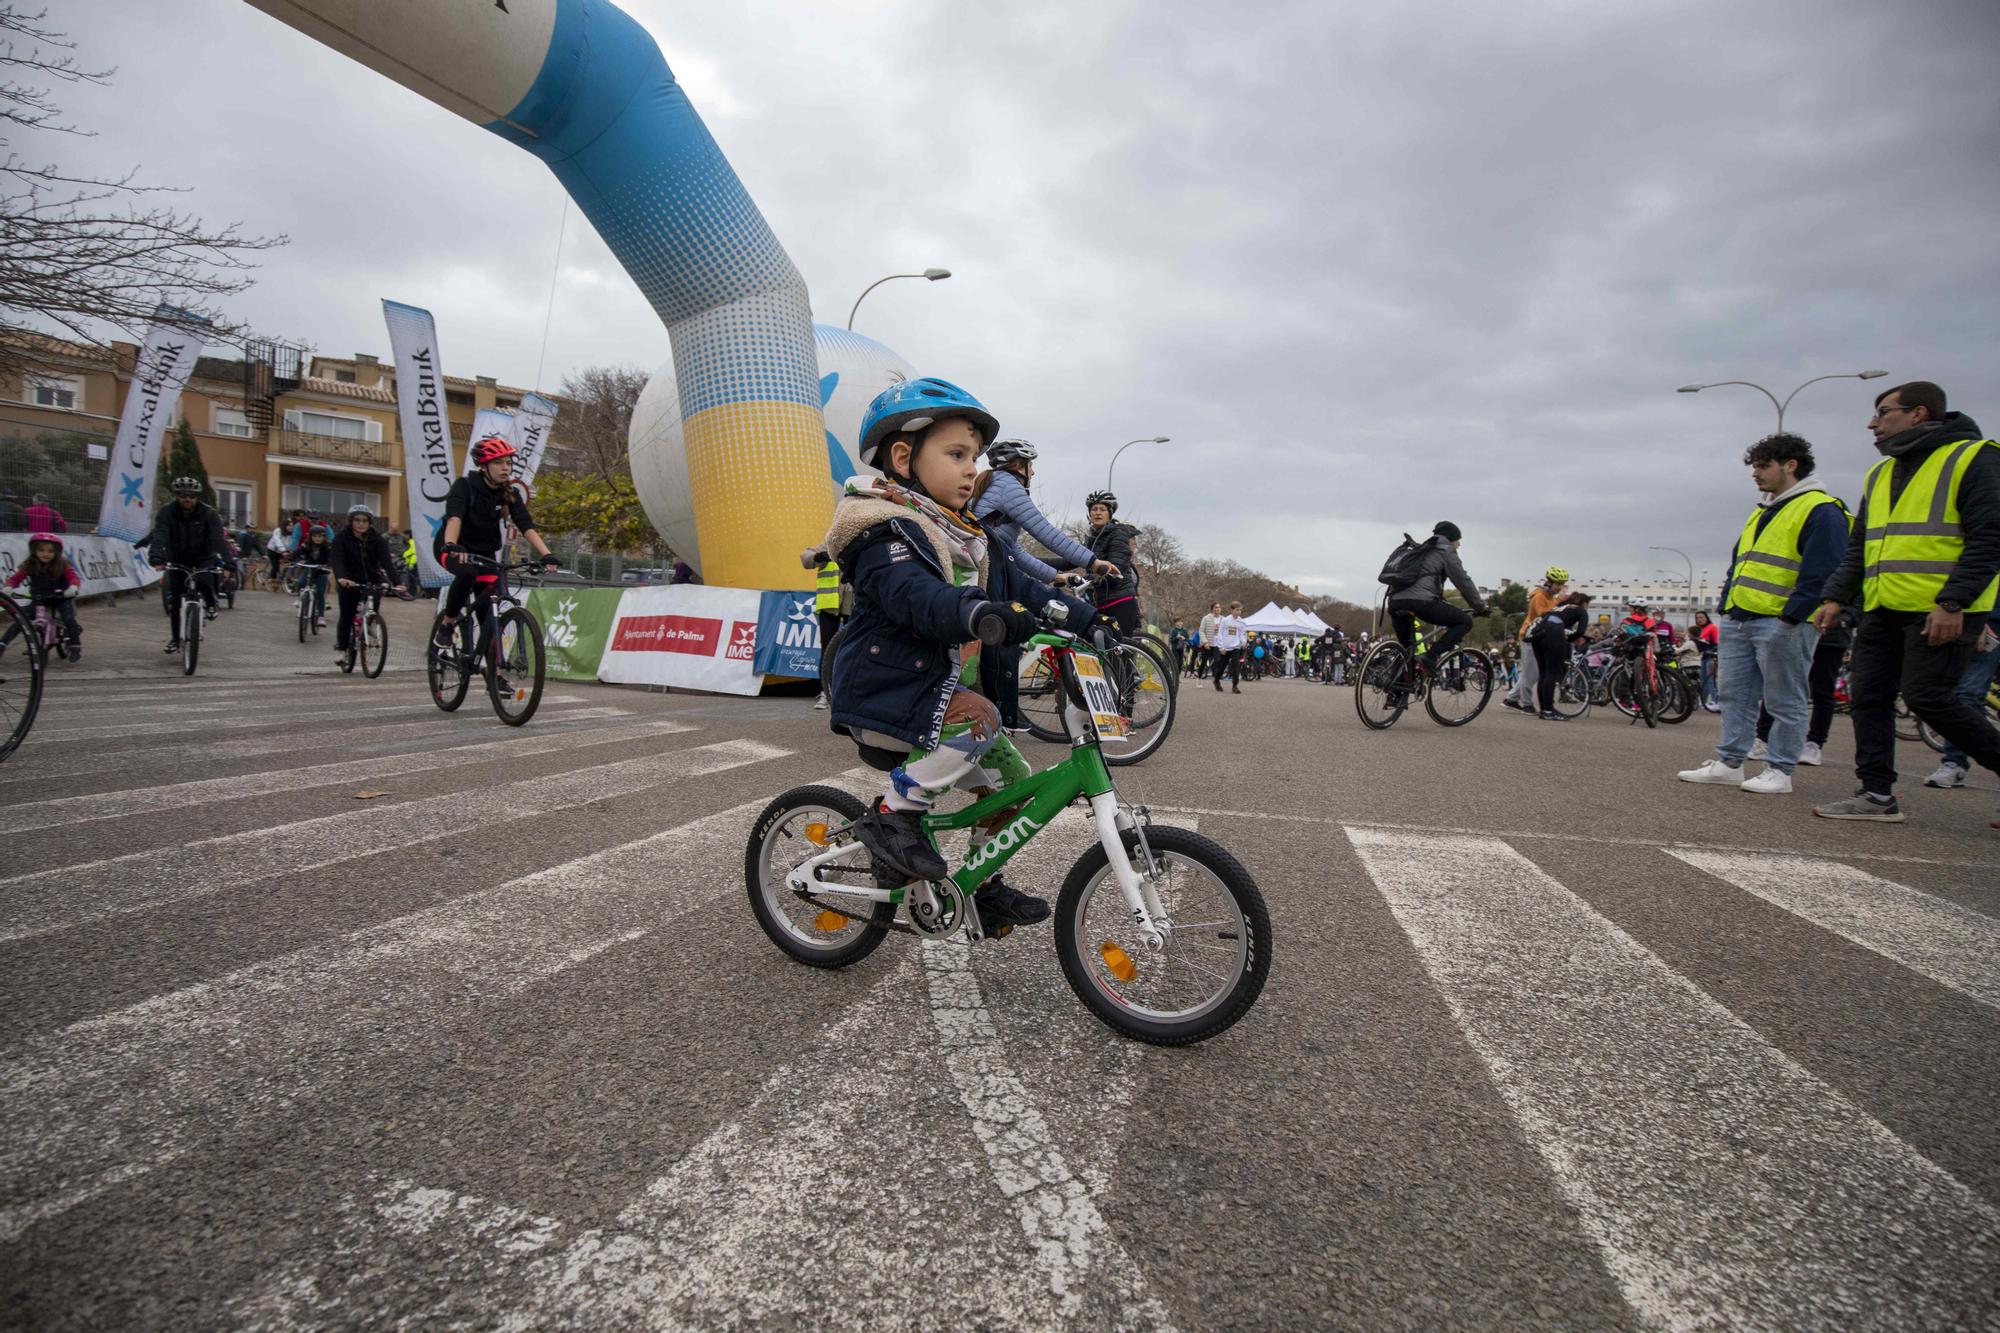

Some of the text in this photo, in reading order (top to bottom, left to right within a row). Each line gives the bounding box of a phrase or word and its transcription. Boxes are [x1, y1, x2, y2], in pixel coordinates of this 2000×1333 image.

[129, 341, 185, 469] CaixaBank
[411, 347, 452, 503] CaixaBank
[511, 424, 542, 480] aBank
[624, 625, 705, 641] Ajuntament de Palma
[759, 807, 787, 840] KENDA
[965, 816, 1043, 871] woom
[1133, 907, 1146, 925] 14
[1243, 914, 1254, 971] KENDA
